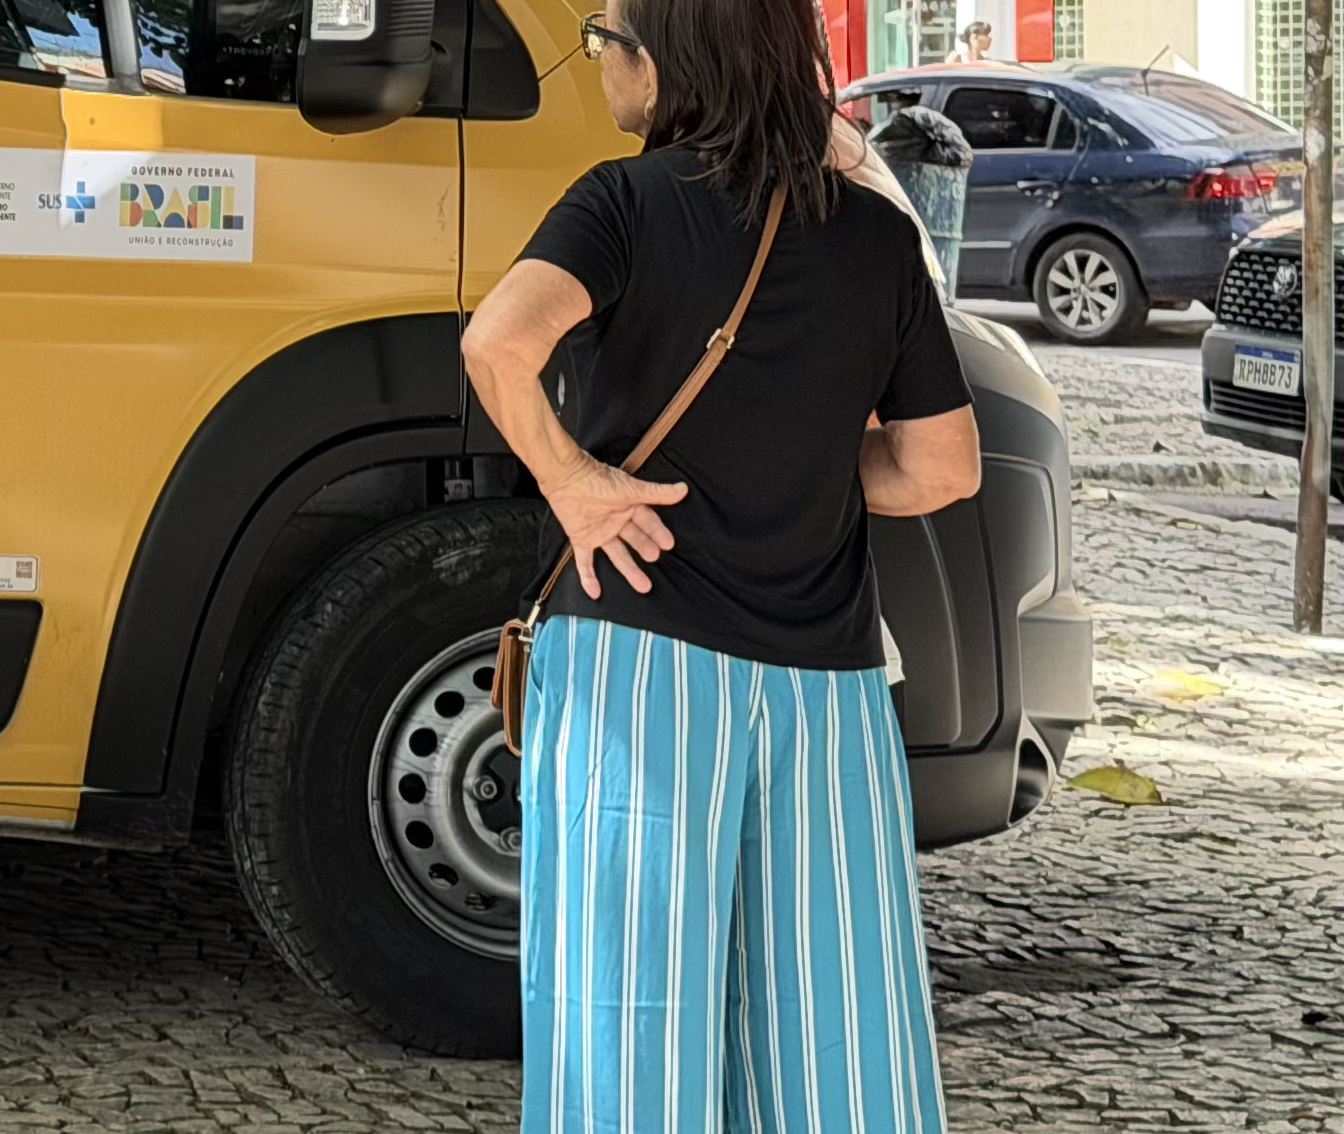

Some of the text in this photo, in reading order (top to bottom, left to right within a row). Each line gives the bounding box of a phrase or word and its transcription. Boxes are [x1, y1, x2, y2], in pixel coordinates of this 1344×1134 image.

[131, 166, 235, 178] GOVERNO FEDERAL
[38, 193, 62, 209] SUS
[119, 182, 244, 230] BRASIL
[128, 235, 234, 247] UNIÃO E RECONSTRUÇÃO
